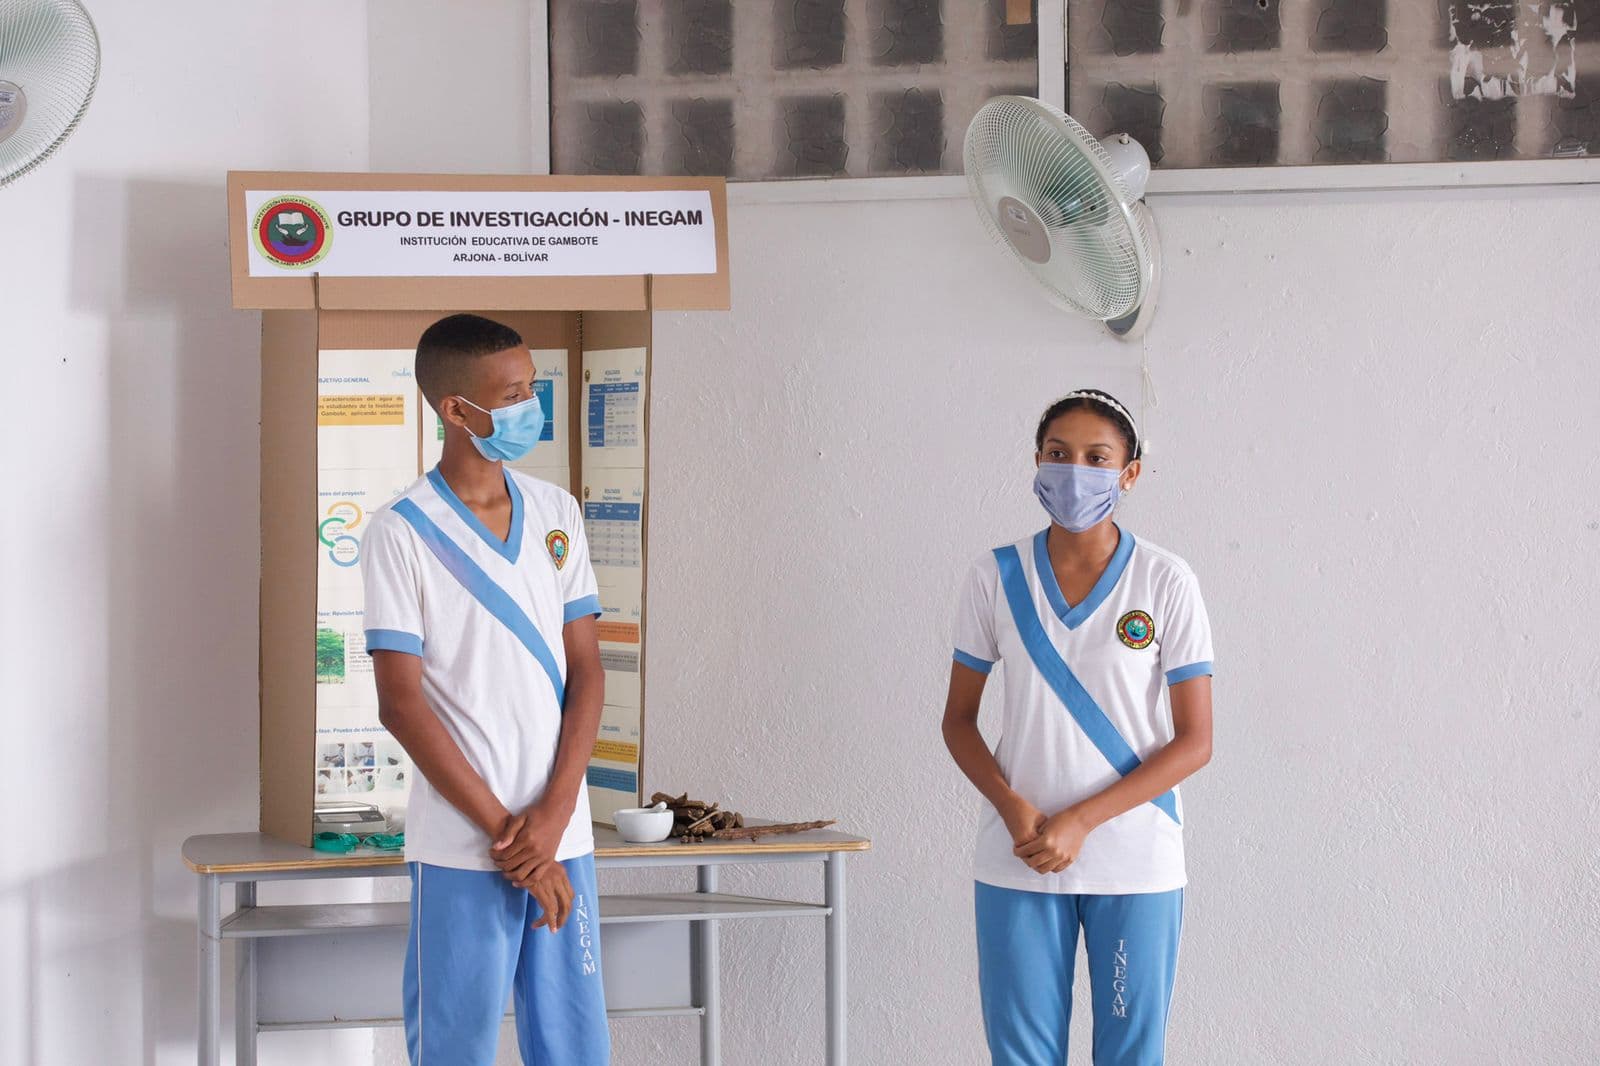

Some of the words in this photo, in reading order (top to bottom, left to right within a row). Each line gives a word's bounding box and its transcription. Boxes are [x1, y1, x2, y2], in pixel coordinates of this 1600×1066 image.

[337, 210, 412, 227] GRUPO
[416, 211, 445, 227] DE
[449, 208, 609, 227] INVESTIGACIÓN
[624, 209, 703, 226] INEGAM
[400, 235, 467, 246] INSTITUCIÓN
[471, 236, 529, 246] EDUCATIVA
[532, 236, 546, 246] DE
[548, 236, 599, 246] GAMBOTE
[452, 253, 496, 262] ARJONA
[503, 251, 549, 262] BOLÍVAR
[575, 894, 596, 976] INEGAM
[1111, 938, 1128, 1018] INEGAM
